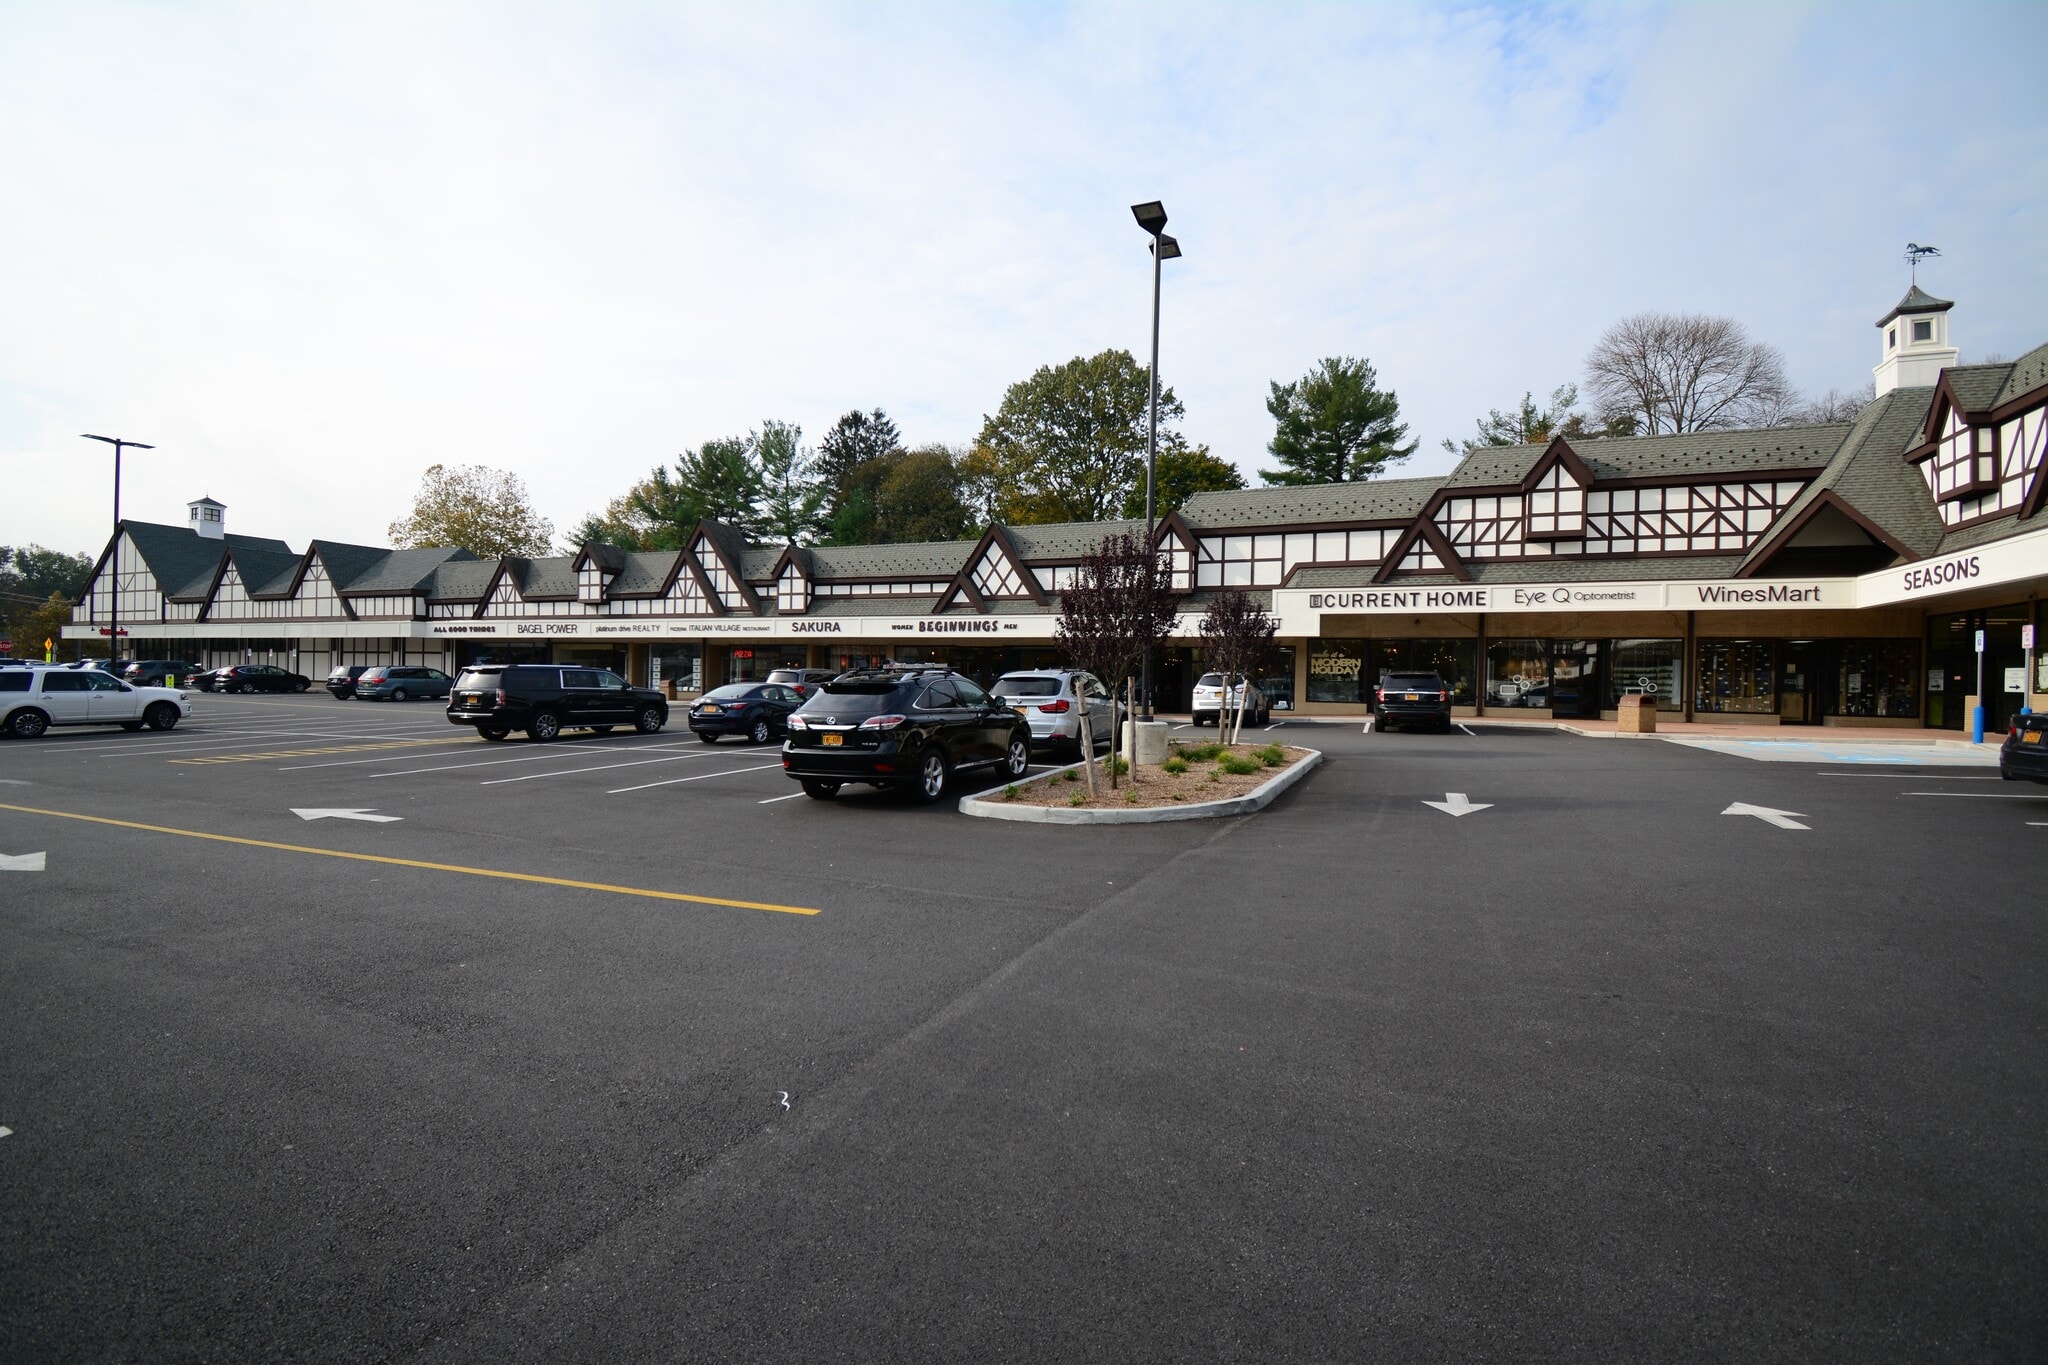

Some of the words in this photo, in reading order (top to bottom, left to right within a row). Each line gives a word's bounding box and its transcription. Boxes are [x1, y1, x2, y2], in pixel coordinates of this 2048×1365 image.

[1904, 556, 1980, 591] SEASONS
[1514, 589, 1546, 606] Eye
[1552, 588, 1570, 603] Q
[1574, 591, 1636, 602] Optometrist
[1698, 586, 1821, 603] WinesMart
[1324, 592, 1420, 608] CURRENT
[1427, 591, 1487, 607] HOME
[517, 624, 544, 633] BAGEL
[546, 624, 578, 633] POWER
[595, 625, 618, 633] platinum
[689, 624, 713, 632] ITALIAN
[714, 624, 741, 632] VILLAGE
[792, 622, 841, 632] SAKURA
[919, 620, 999, 632] BEGINNINGS
[734, 649, 753, 658] PIZZA
[1311, 658, 1361, 667] MODERN
[1310, 666, 1361, 675] HOLIDAY
